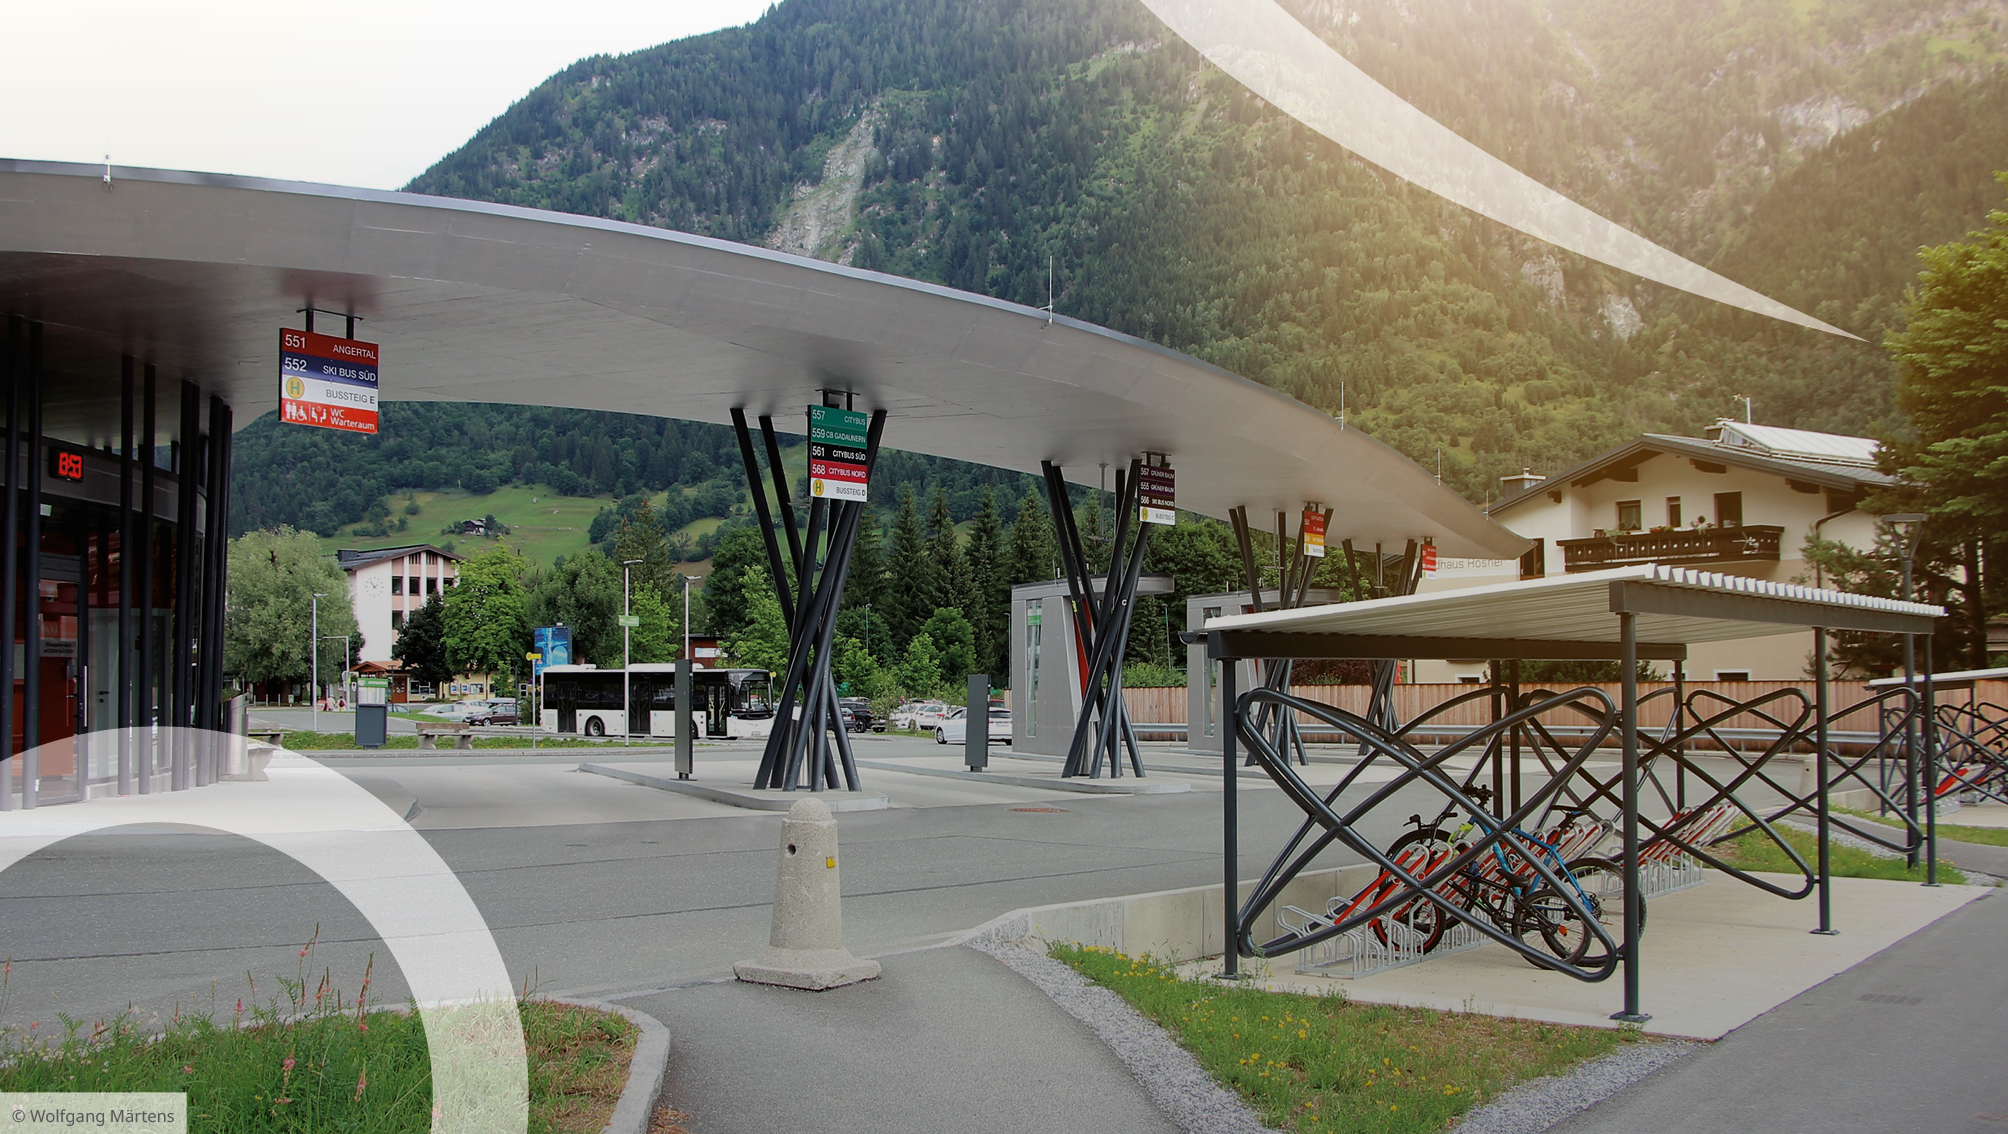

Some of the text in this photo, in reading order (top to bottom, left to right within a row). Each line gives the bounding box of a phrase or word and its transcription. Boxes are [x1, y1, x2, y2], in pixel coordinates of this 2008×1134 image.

[285, 334, 376, 359] 551 ANGERTAL
[284, 357, 376, 381] 552 SKI BUS SÜD
[326, 389, 367, 403] BUSSTEIG
[369, 396, 375, 404] E
[330, 408, 345, 418] WC
[812, 410, 866, 426] 557 CITYBUS
[330, 416, 375, 430] Warteraum
[812, 428, 825, 439] 559
[812, 446, 866, 461] 561 CITYBUS SÜD
[812, 464, 866, 479] 568 CITYBUS NORD
[836, 486, 861, 496] BUSSTEIG
[1121, 598, 1128, 606] C
